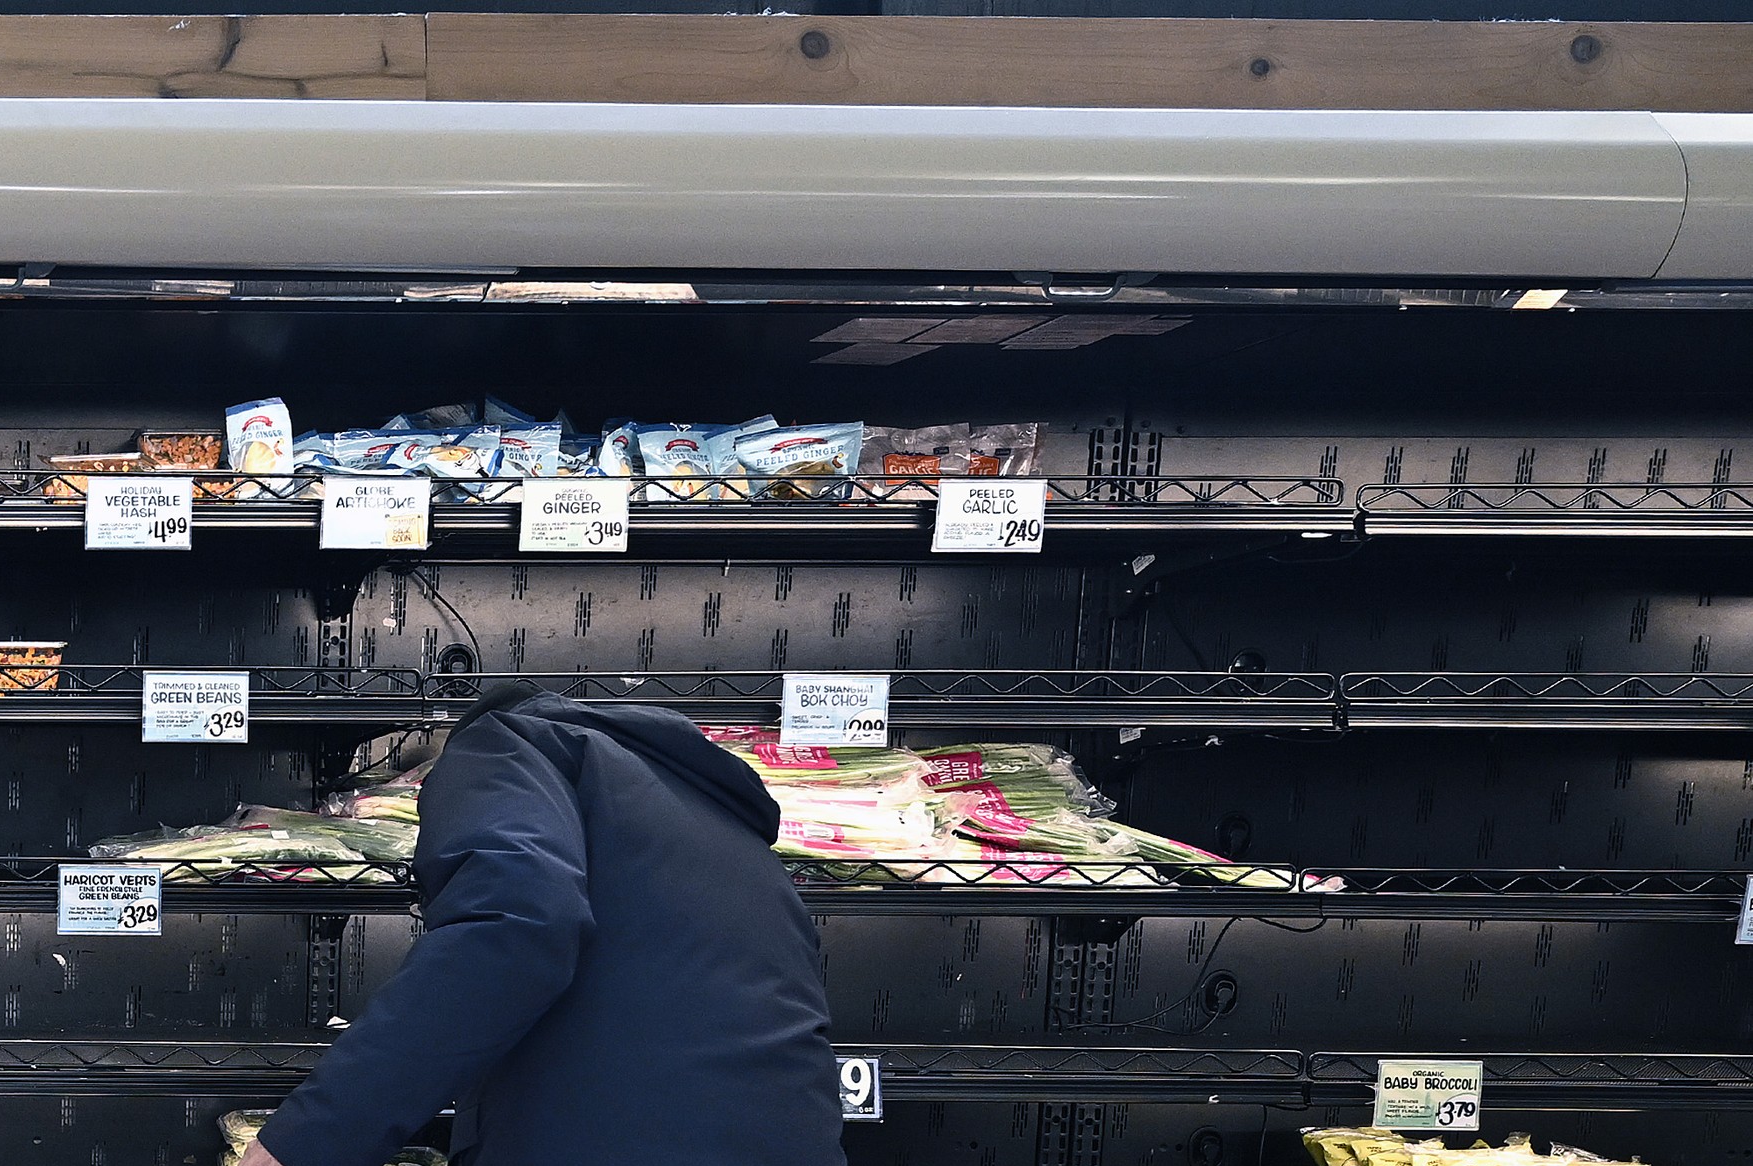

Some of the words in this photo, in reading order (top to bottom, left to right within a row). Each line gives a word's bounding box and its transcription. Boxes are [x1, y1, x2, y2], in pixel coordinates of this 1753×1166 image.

[121, 486, 162, 495] HOLIDAY
[355, 486, 395, 495] GLOBE
[970, 489, 1014, 499] PEELED
[105, 496, 180, 506] VEGETABLE
[555, 493, 593, 501] PEELED
[336, 497, 415, 509] ARTICHOKE
[543, 502, 601, 514] GINGER
[963, 500, 1018, 514] GARLIC
[121, 508, 156, 517] HASH
[205, 683, 240, 691] CLEANED
[795, 685, 821, 693] BABY
[824, 685, 873, 693] SHANGHAI
[151, 692, 194, 703] GREEN
[197, 692, 242, 704] BEANS
[801, 694, 827, 706] BOK
[831, 694, 868, 706] CHOY
[64, 875, 115, 885] HARICOT
[118, 876, 156, 886] VERTS
[1384, 1077, 1418, 1090] BABY
[1424, 1078, 1477, 1090] BROCCOLI
